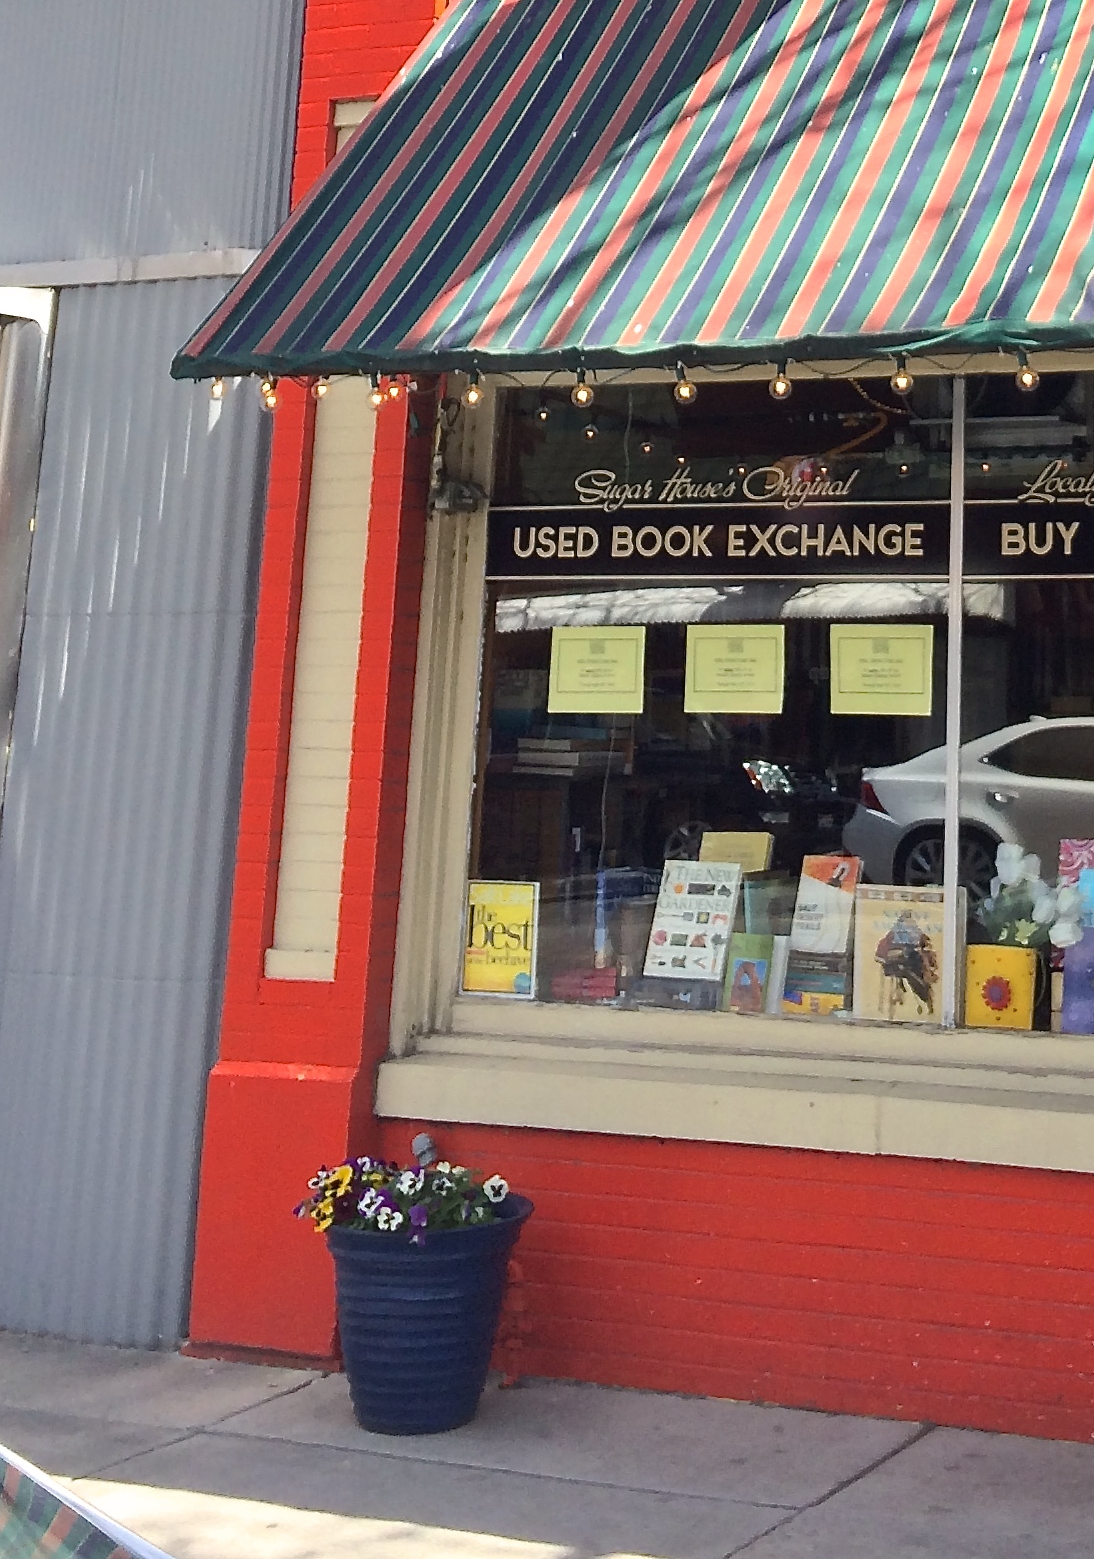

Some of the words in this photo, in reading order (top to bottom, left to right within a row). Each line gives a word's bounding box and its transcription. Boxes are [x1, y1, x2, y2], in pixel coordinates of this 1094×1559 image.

[575, 469, 654, 512] Sugar
[659, 467, 737, 503] House's
[742, 467, 860, 510] Original
[513, 526, 599, 558] USED
[611, 525, 714, 557] BOOK
[727, 523, 925, 556] EXCHANGE
[1000, 521, 1080, 556] BUY
[676, 865, 704, 881] THE
[658, 894, 733, 912] GARDENER
[467, 905, 534, 951] best
